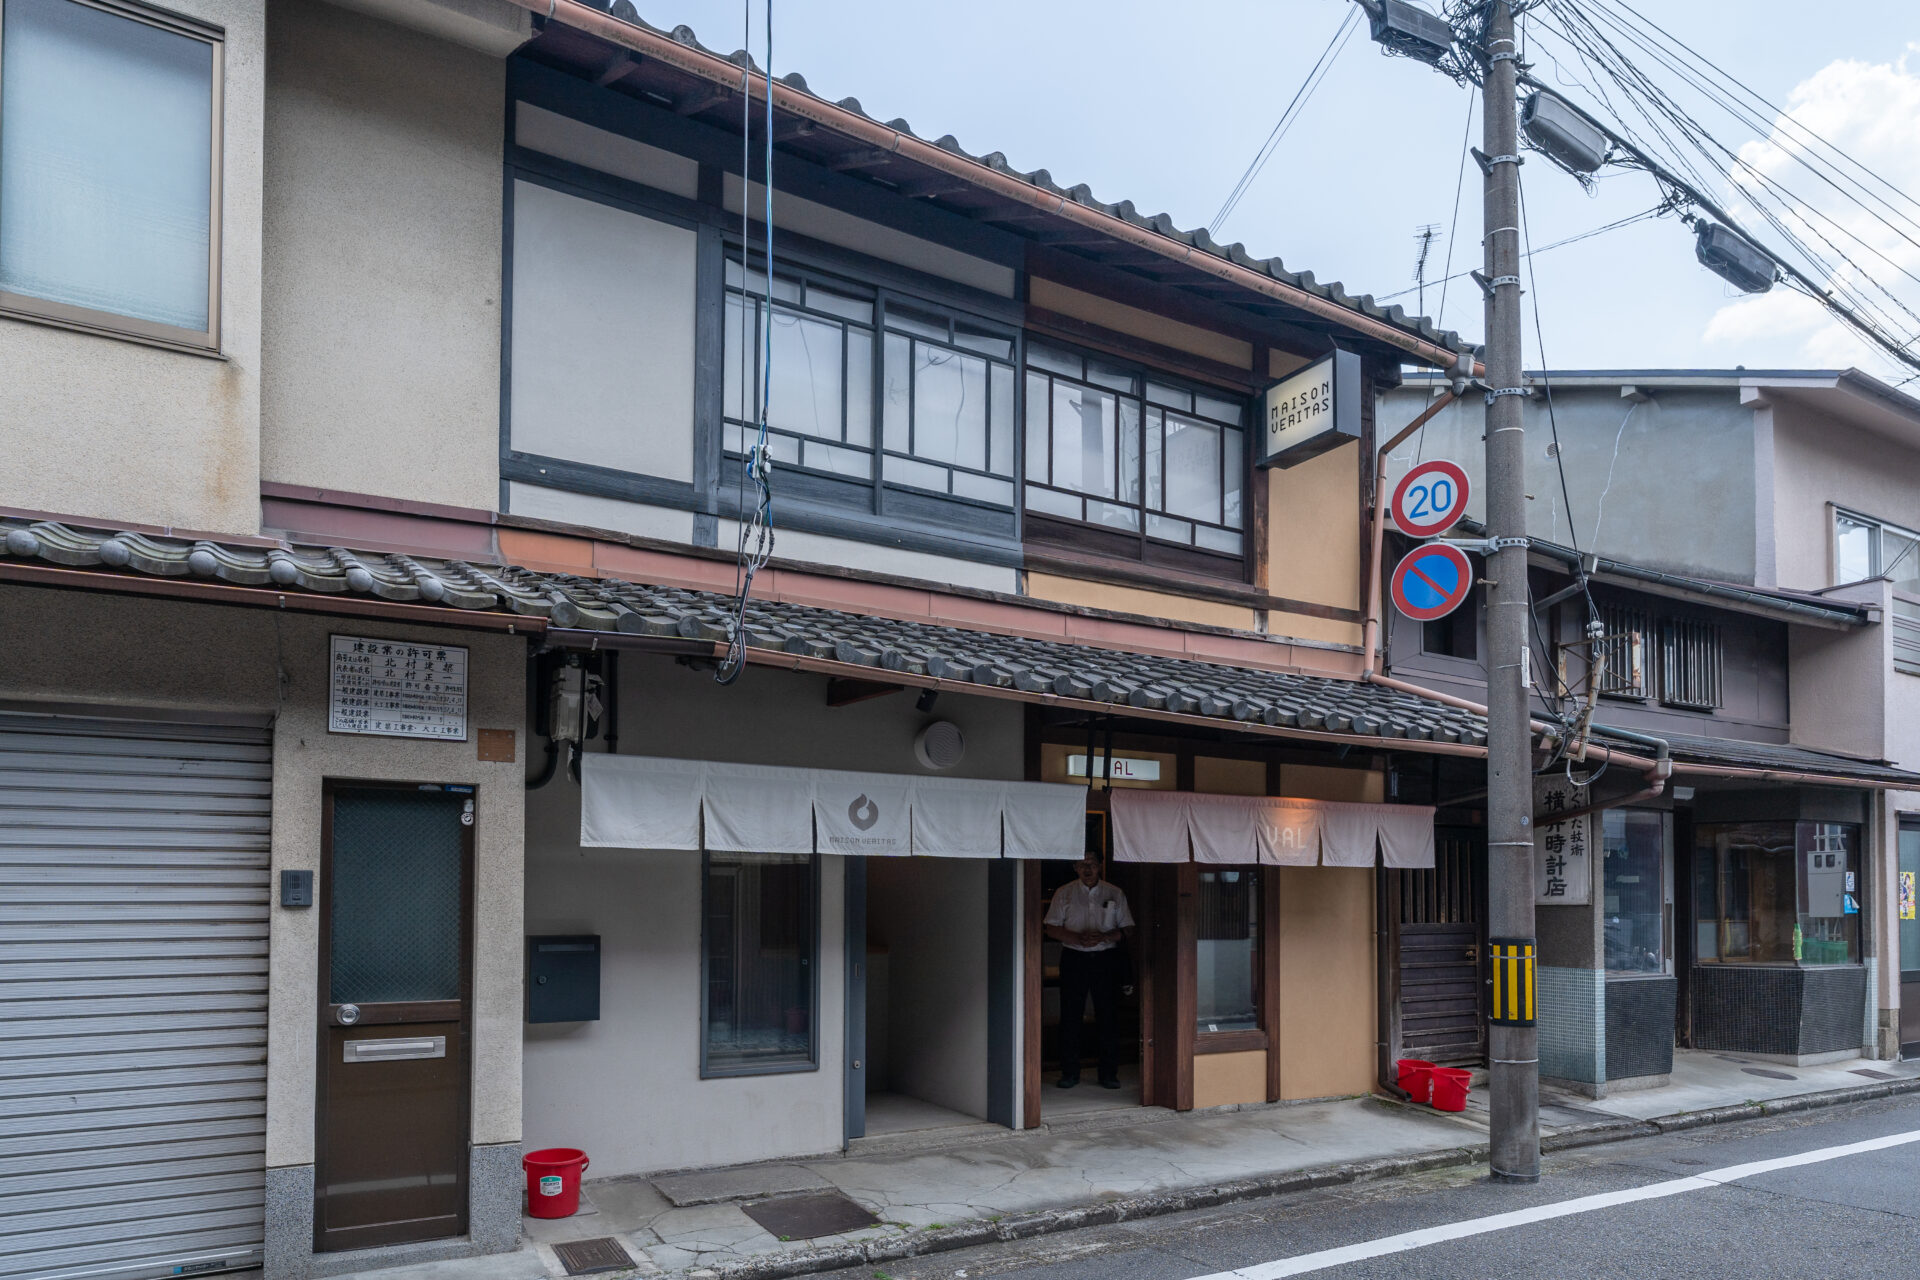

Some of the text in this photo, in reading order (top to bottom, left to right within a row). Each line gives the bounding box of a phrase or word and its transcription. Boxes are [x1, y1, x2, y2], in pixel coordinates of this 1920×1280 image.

[1271, 380, 1329, 420] MAISON
[1271, 398, 1329, 434] VERITAS
[1409, 480, 1451, 519] 20
[353, 642, 447, 661] 建設業の許可票
[385, 658, 453, 673] 北村建築
[385, 669, 453, 682] 北村正一
[1114, 760, 1133, 776] AL
[1266, 825, 1306, 849] VAL
